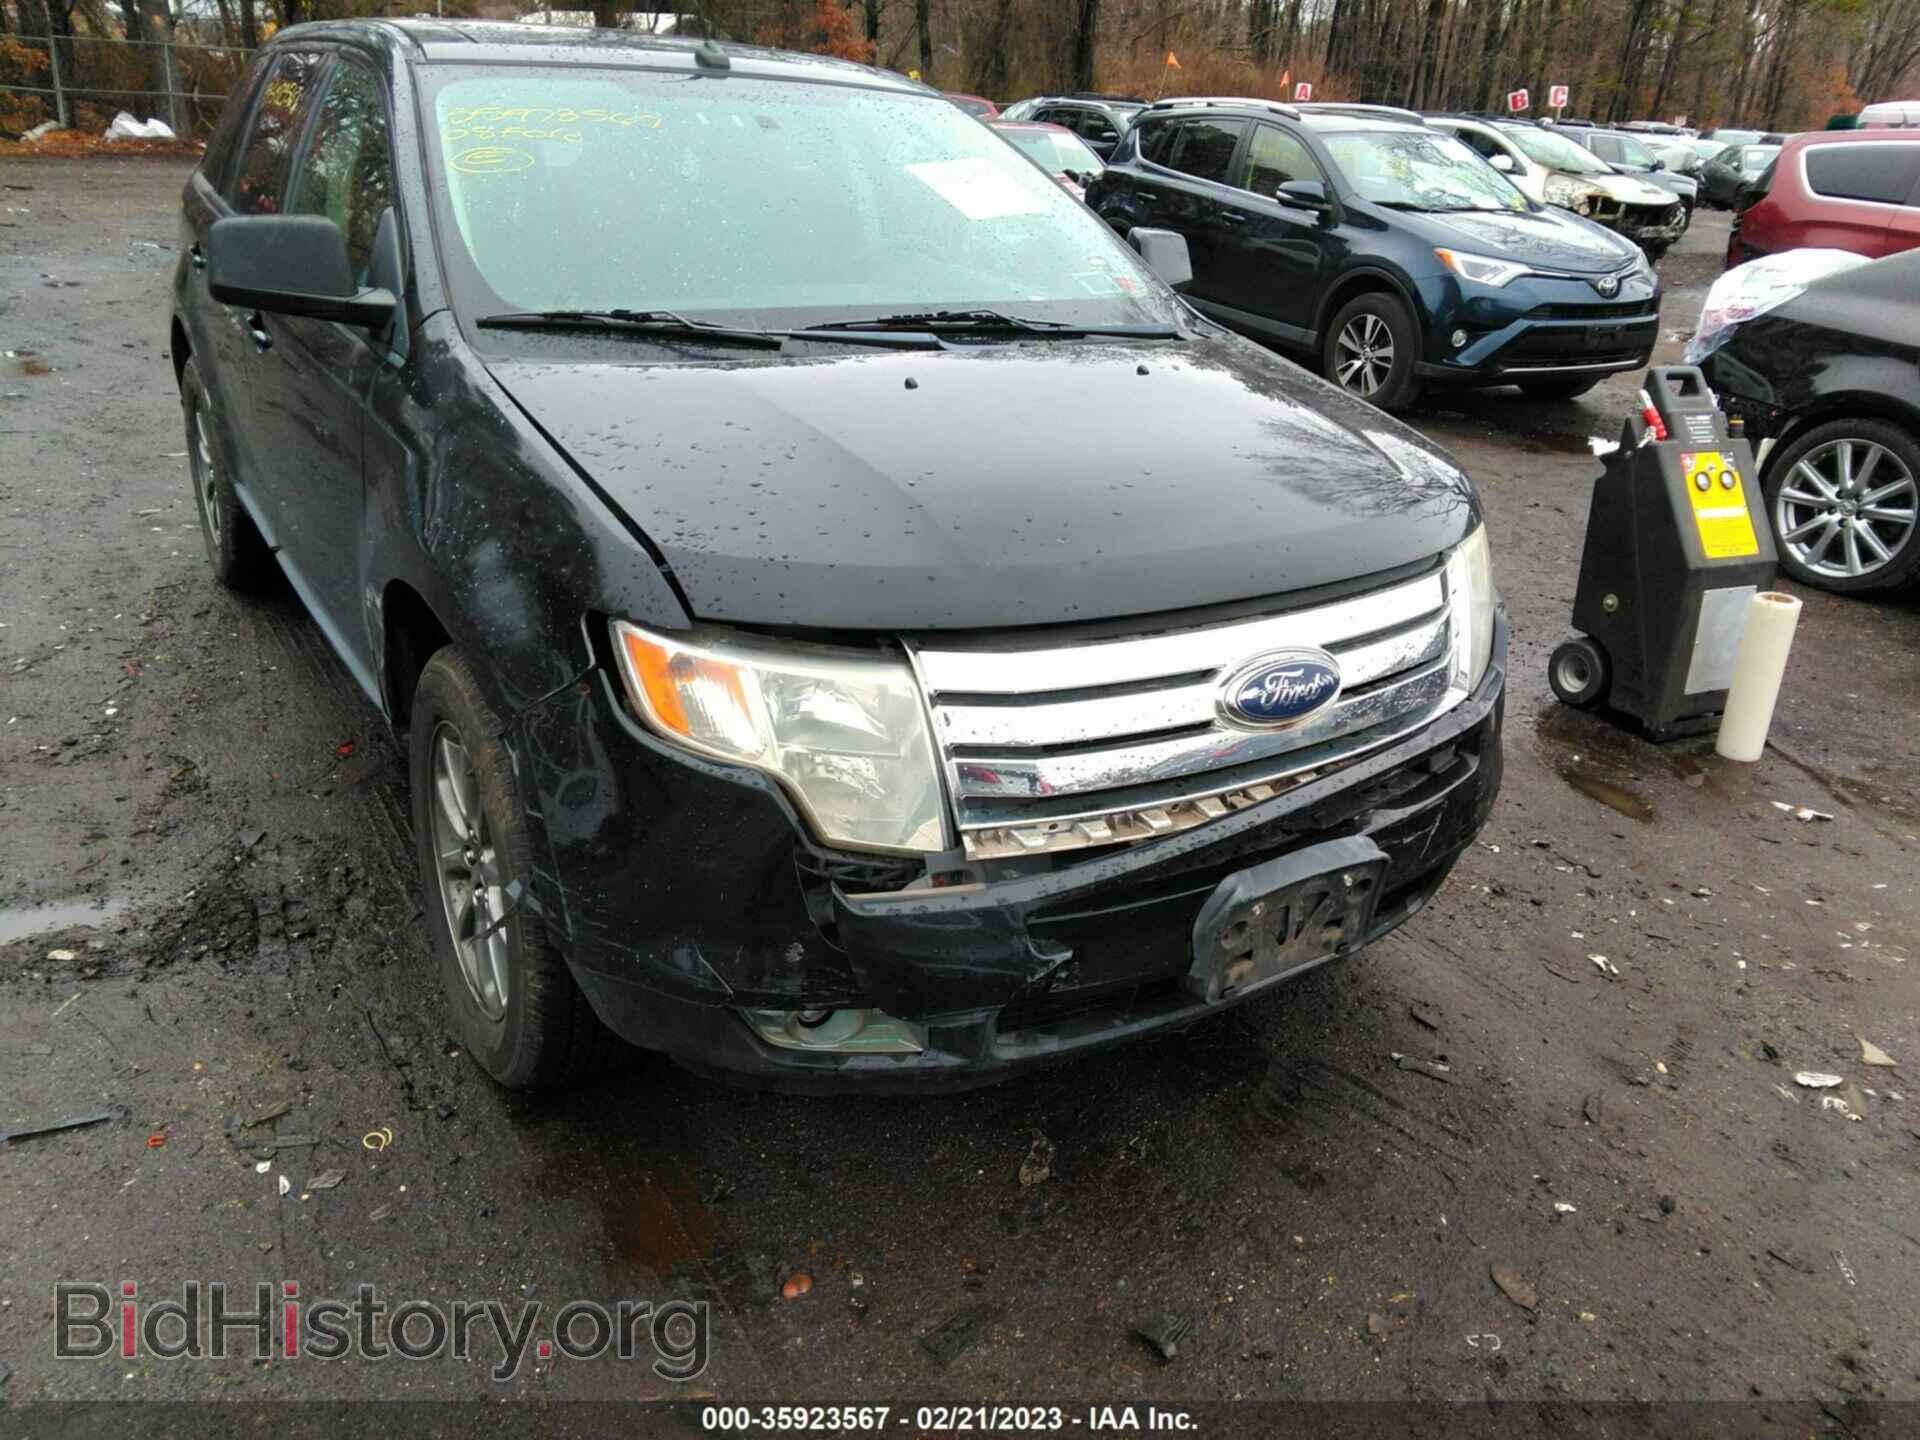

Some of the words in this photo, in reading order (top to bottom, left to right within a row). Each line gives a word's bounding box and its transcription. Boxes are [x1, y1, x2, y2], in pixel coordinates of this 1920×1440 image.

[1297, 84, 1309, 99] A
[1511, 92, 1527, 109] B
[1552, 87, 1567, 106] C
[1259, 667, 1321, 710] Ford
